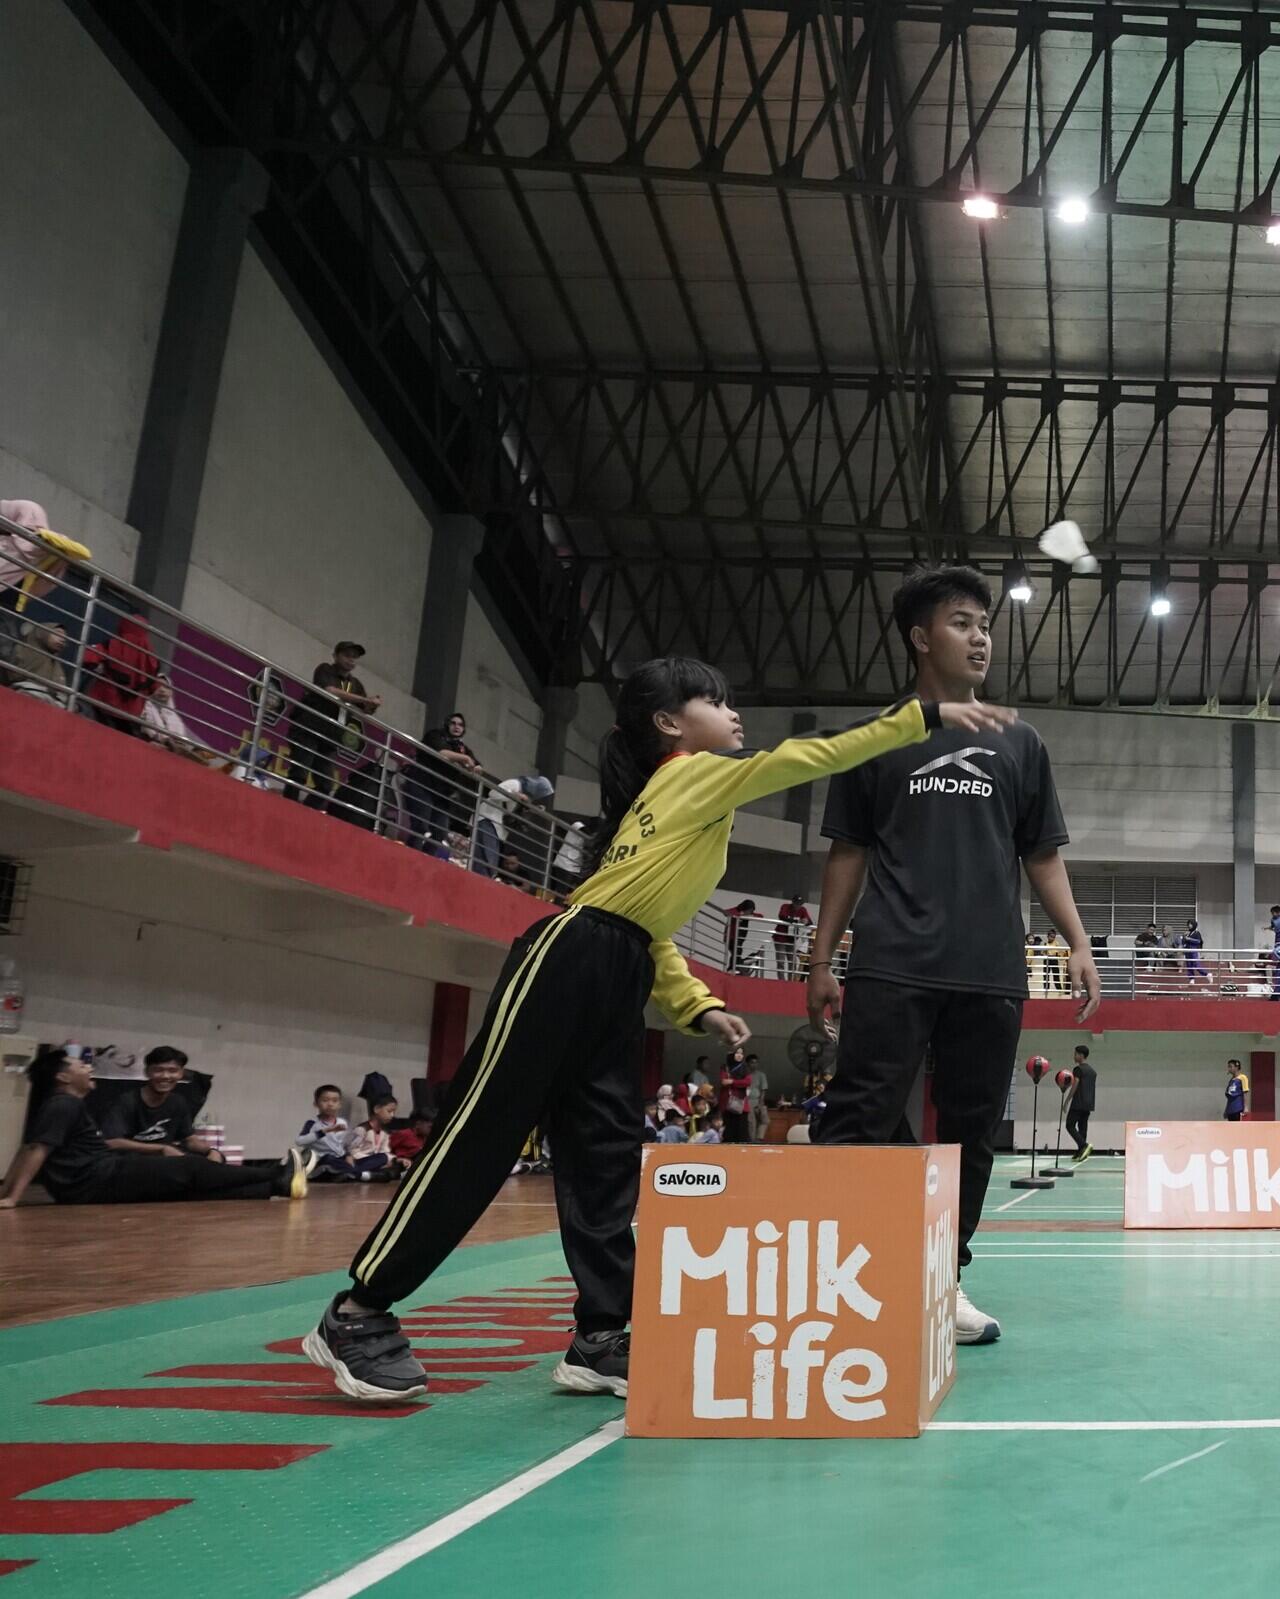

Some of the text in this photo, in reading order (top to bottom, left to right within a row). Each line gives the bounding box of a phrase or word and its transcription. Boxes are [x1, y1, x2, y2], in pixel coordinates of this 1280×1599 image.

[909, 777, 993, 797] HUNDRED
[659, 1169, 721, 1187] SAVORIA
[660, 1220, 883, 1322] Milk
[693, 1321, 888, 1422] Life
